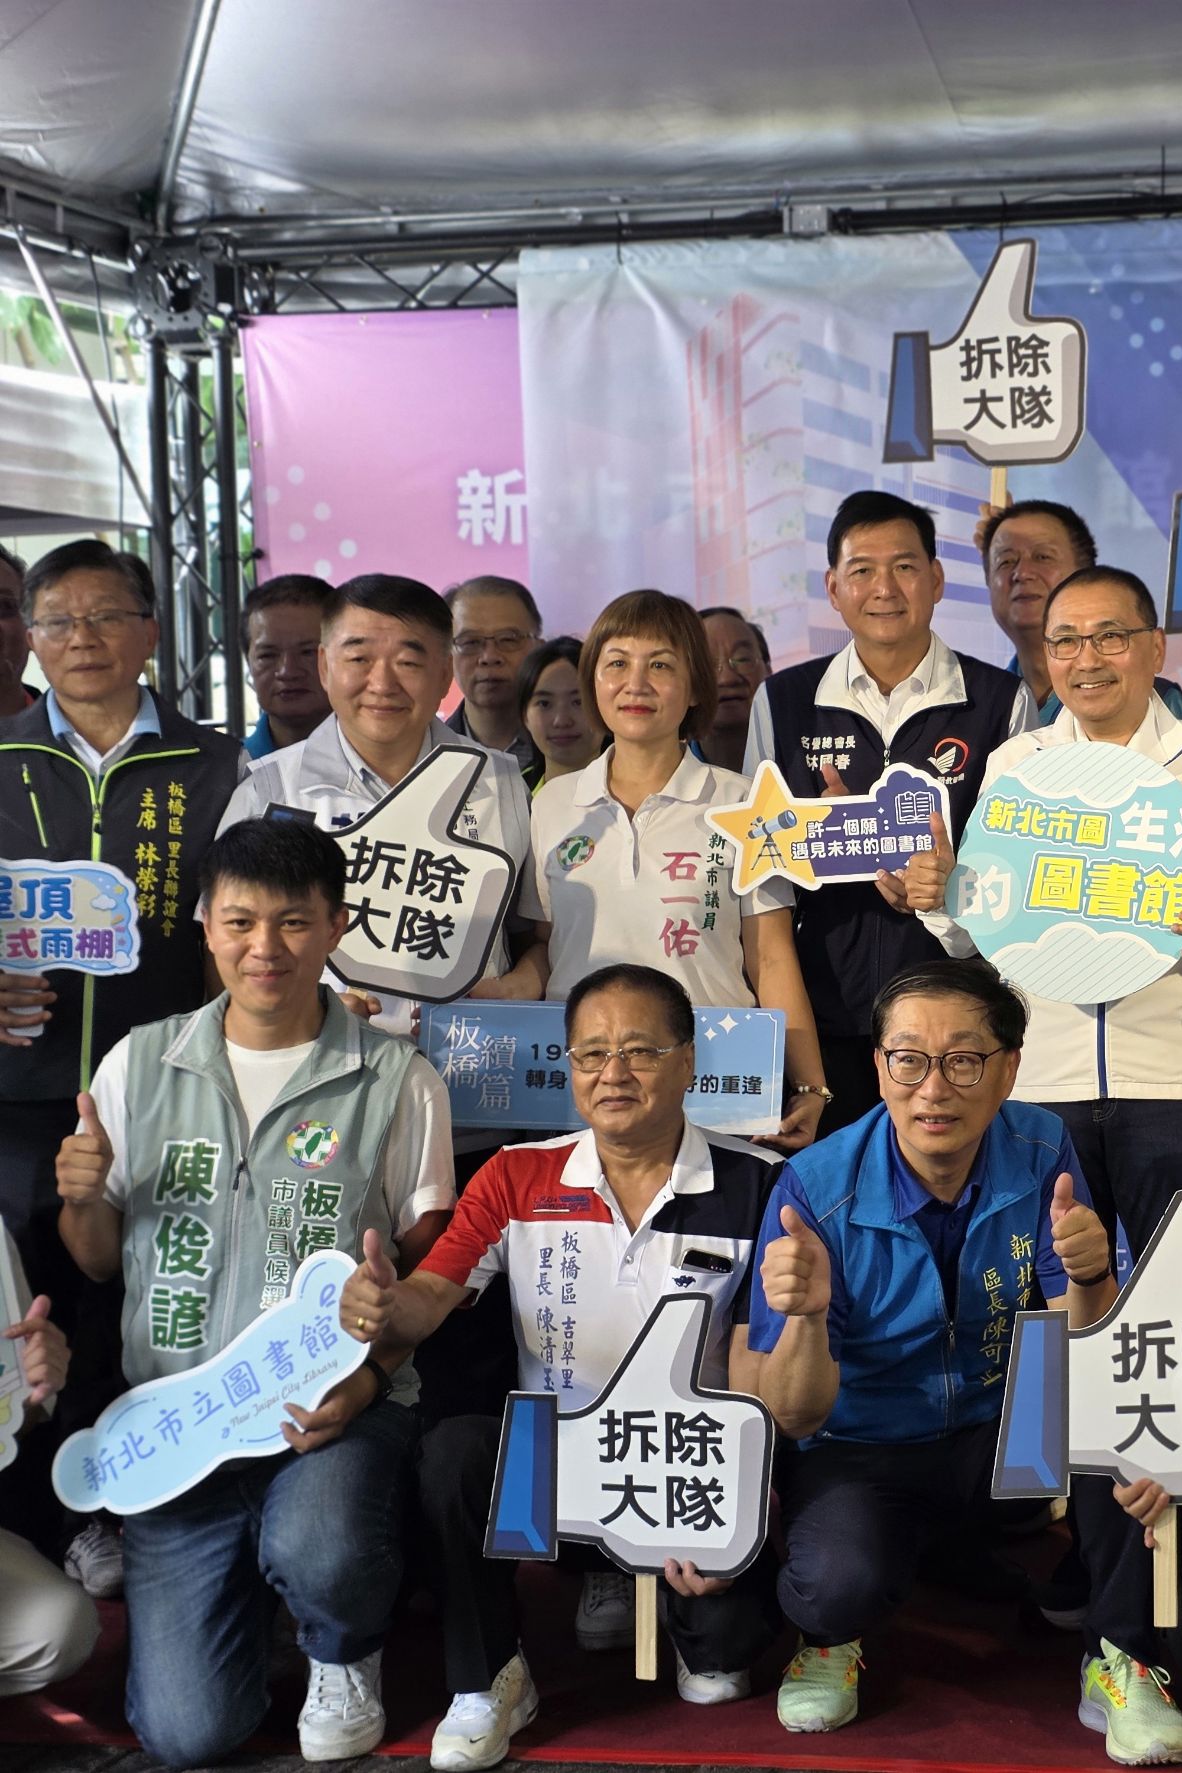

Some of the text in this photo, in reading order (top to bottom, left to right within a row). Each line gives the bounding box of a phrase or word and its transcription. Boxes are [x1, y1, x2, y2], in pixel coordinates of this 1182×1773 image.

[959, 334, 1052, 381] 拆除
[962, 386, 1054, 431] 大隊
[136, 788, 157, 830] 主席
[985, 799, 1107, 846] 新北市圖
[345, 836, 470, 905] 拆除
[791, 834, 933, 861] 遇見未來的圖書館
[659, 850, 701, 958] 石一佑
[701, 833, 726, 931] 新北市議員
[958, 864, 1011, 921] 的
[0, 927, 114, 960] 式雨棚
[344, 896, 456, 961] 大隊
[441, 1015, 517, 1111] 板橋 續篇
[525, 1069, 568, 1089] 轉身
[151, 1139, 220, 1350] 陳俊諺
[295, 1181, 343, 1258] 板橋
[536, 1246, 553, 1296] 里長
[561, 1231, 582, 1305] 板橋區
[1010, 1233, 1033, 1309] 新北市
[83, 1315, 338, 1491] 新北市立圖書館
[281, 1381, 300, 1400] City
[598, 1408, 725, 1467] 拆除
[600, 1475, 726, 1532] 大隊
